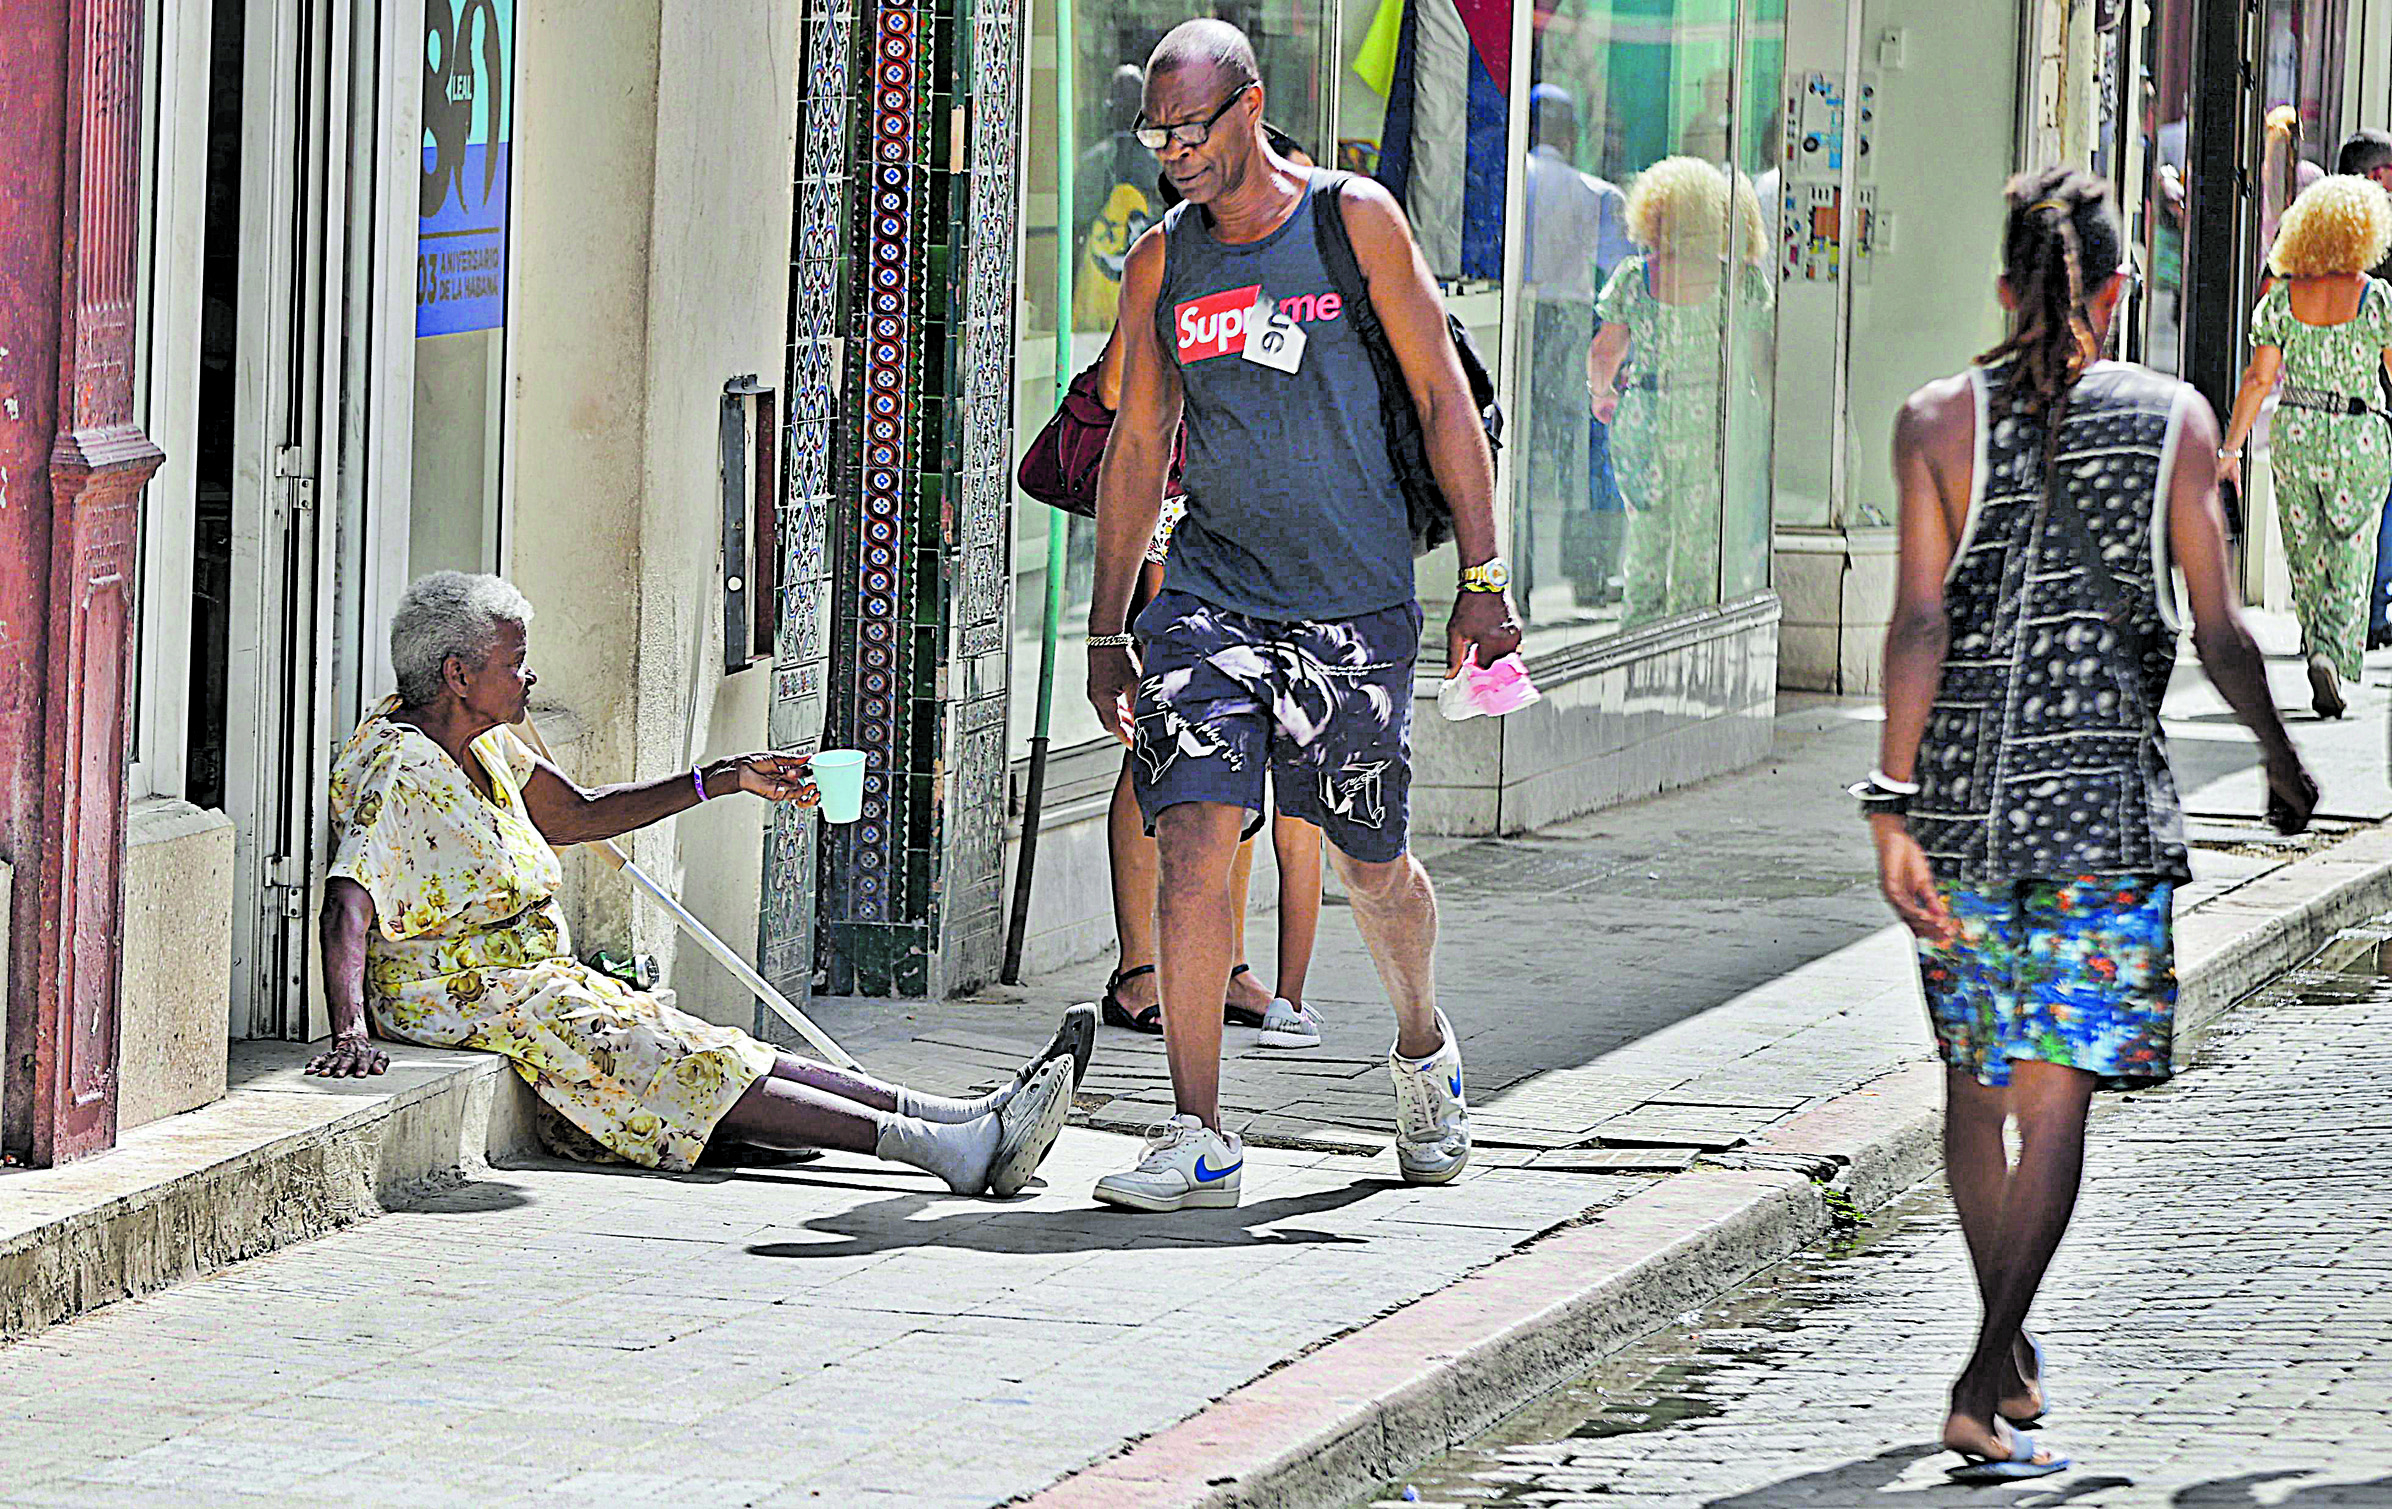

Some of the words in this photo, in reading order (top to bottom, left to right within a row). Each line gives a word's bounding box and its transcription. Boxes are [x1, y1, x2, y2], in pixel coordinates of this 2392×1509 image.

[452, 75, 472, 101] LEAL
[441, 247, 498, 274] ANIVERSARIO
[439, 279, 450, 301] DE
[452, 277, 463, 301] LA
[465, 273, 498, 298] HABANA
